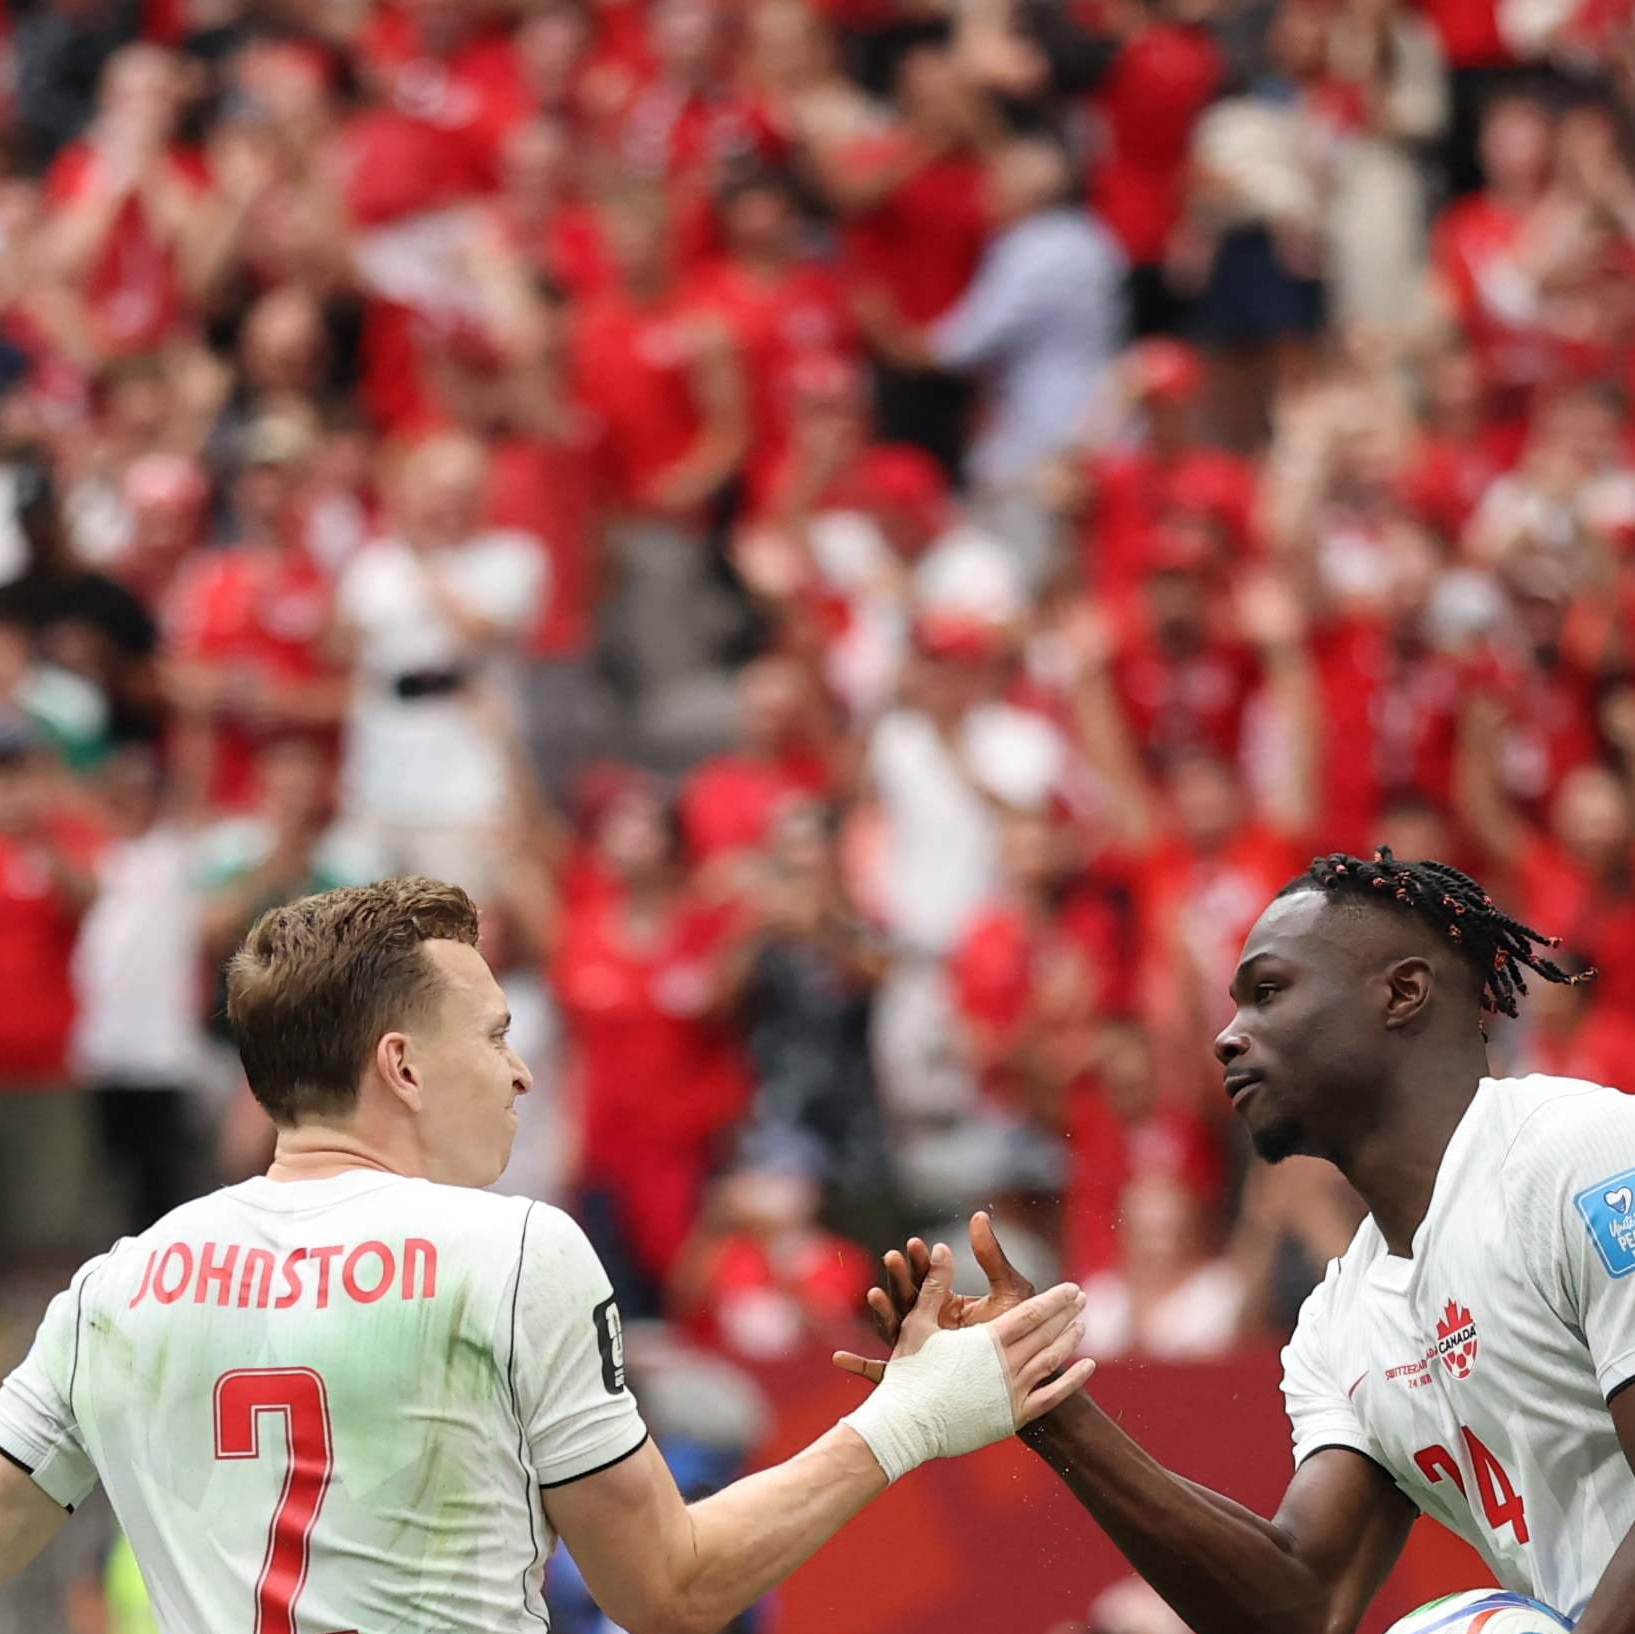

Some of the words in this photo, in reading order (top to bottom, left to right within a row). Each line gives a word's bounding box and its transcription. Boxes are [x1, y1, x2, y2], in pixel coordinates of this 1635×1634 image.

[129, 1238, 437, 1309] JOHNSTON
[1437, 1323, 1478, 1354] CANADA
[1413, 1424, 1530, 1545] 24
